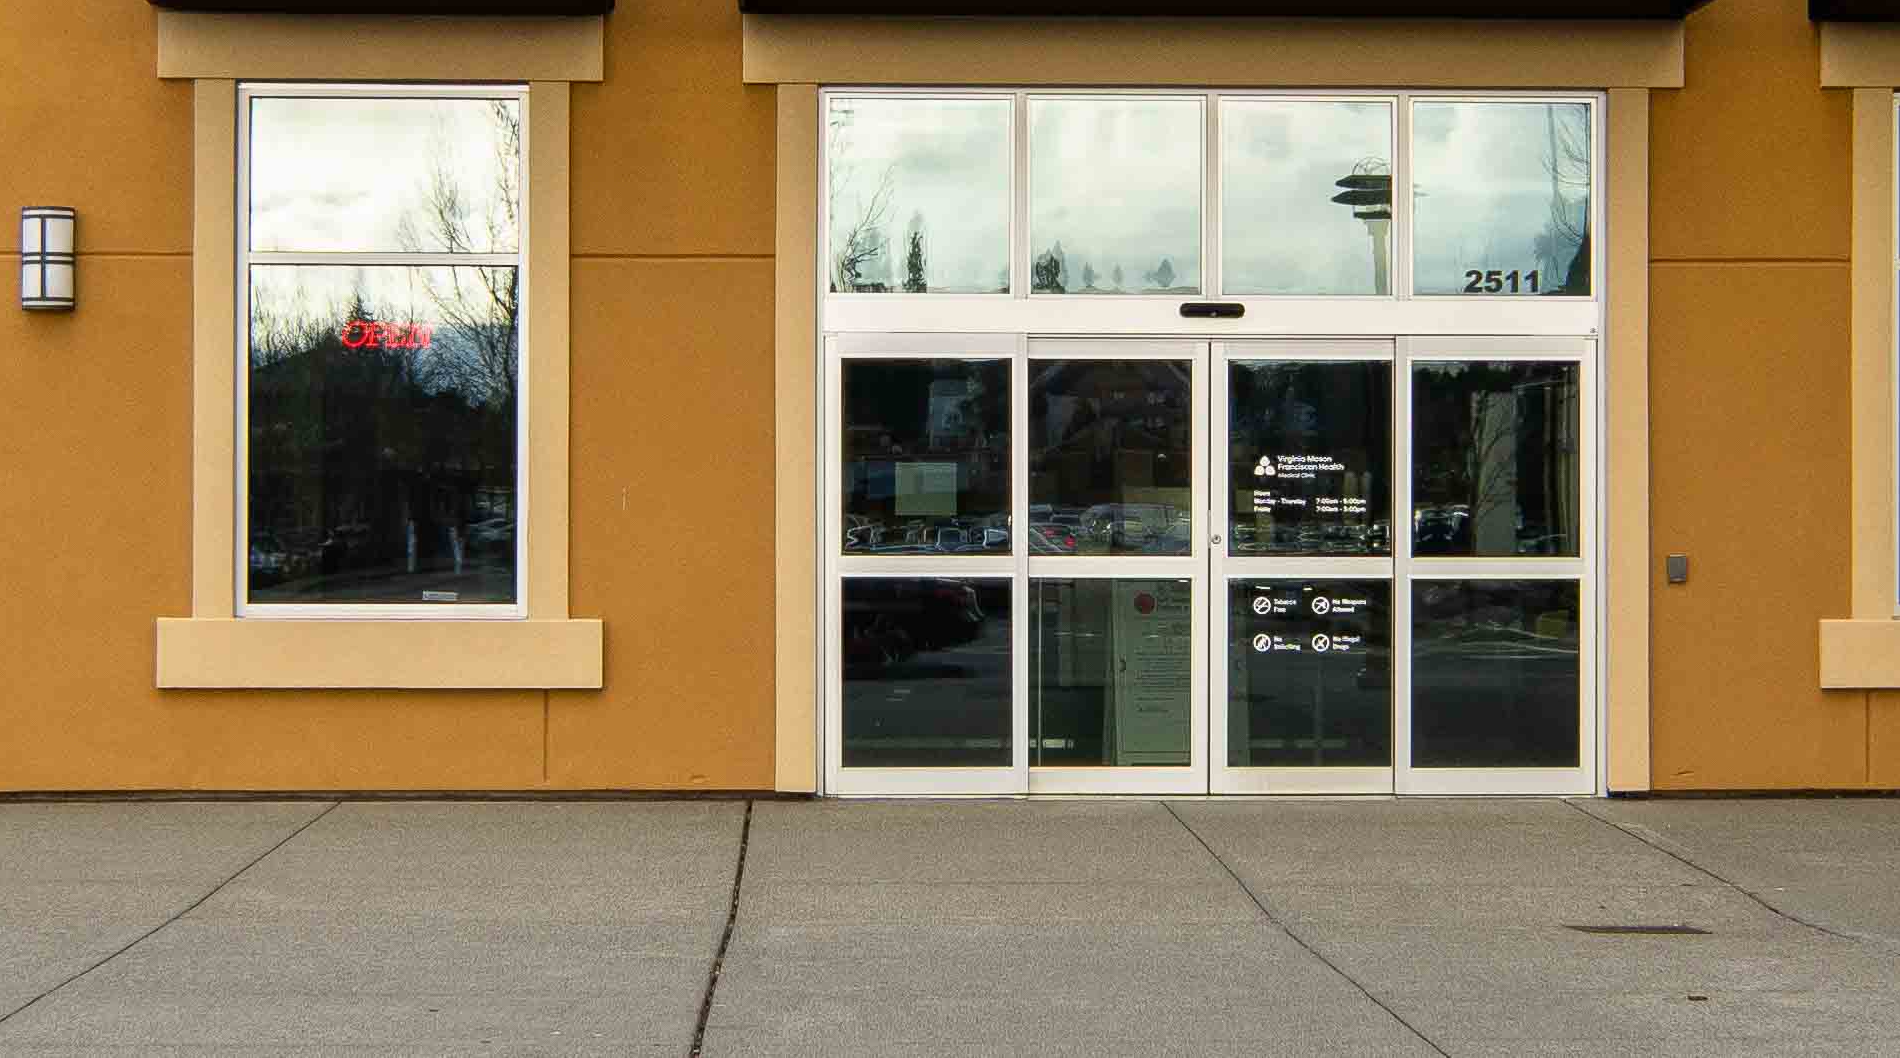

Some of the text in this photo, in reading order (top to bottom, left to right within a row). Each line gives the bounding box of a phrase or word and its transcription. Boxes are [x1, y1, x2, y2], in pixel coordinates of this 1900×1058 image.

[1464, 270, 1538, 293] 2511
[341, 319, 432, 350] OPEN
[1278, 455, 1306, 464] Virginia
